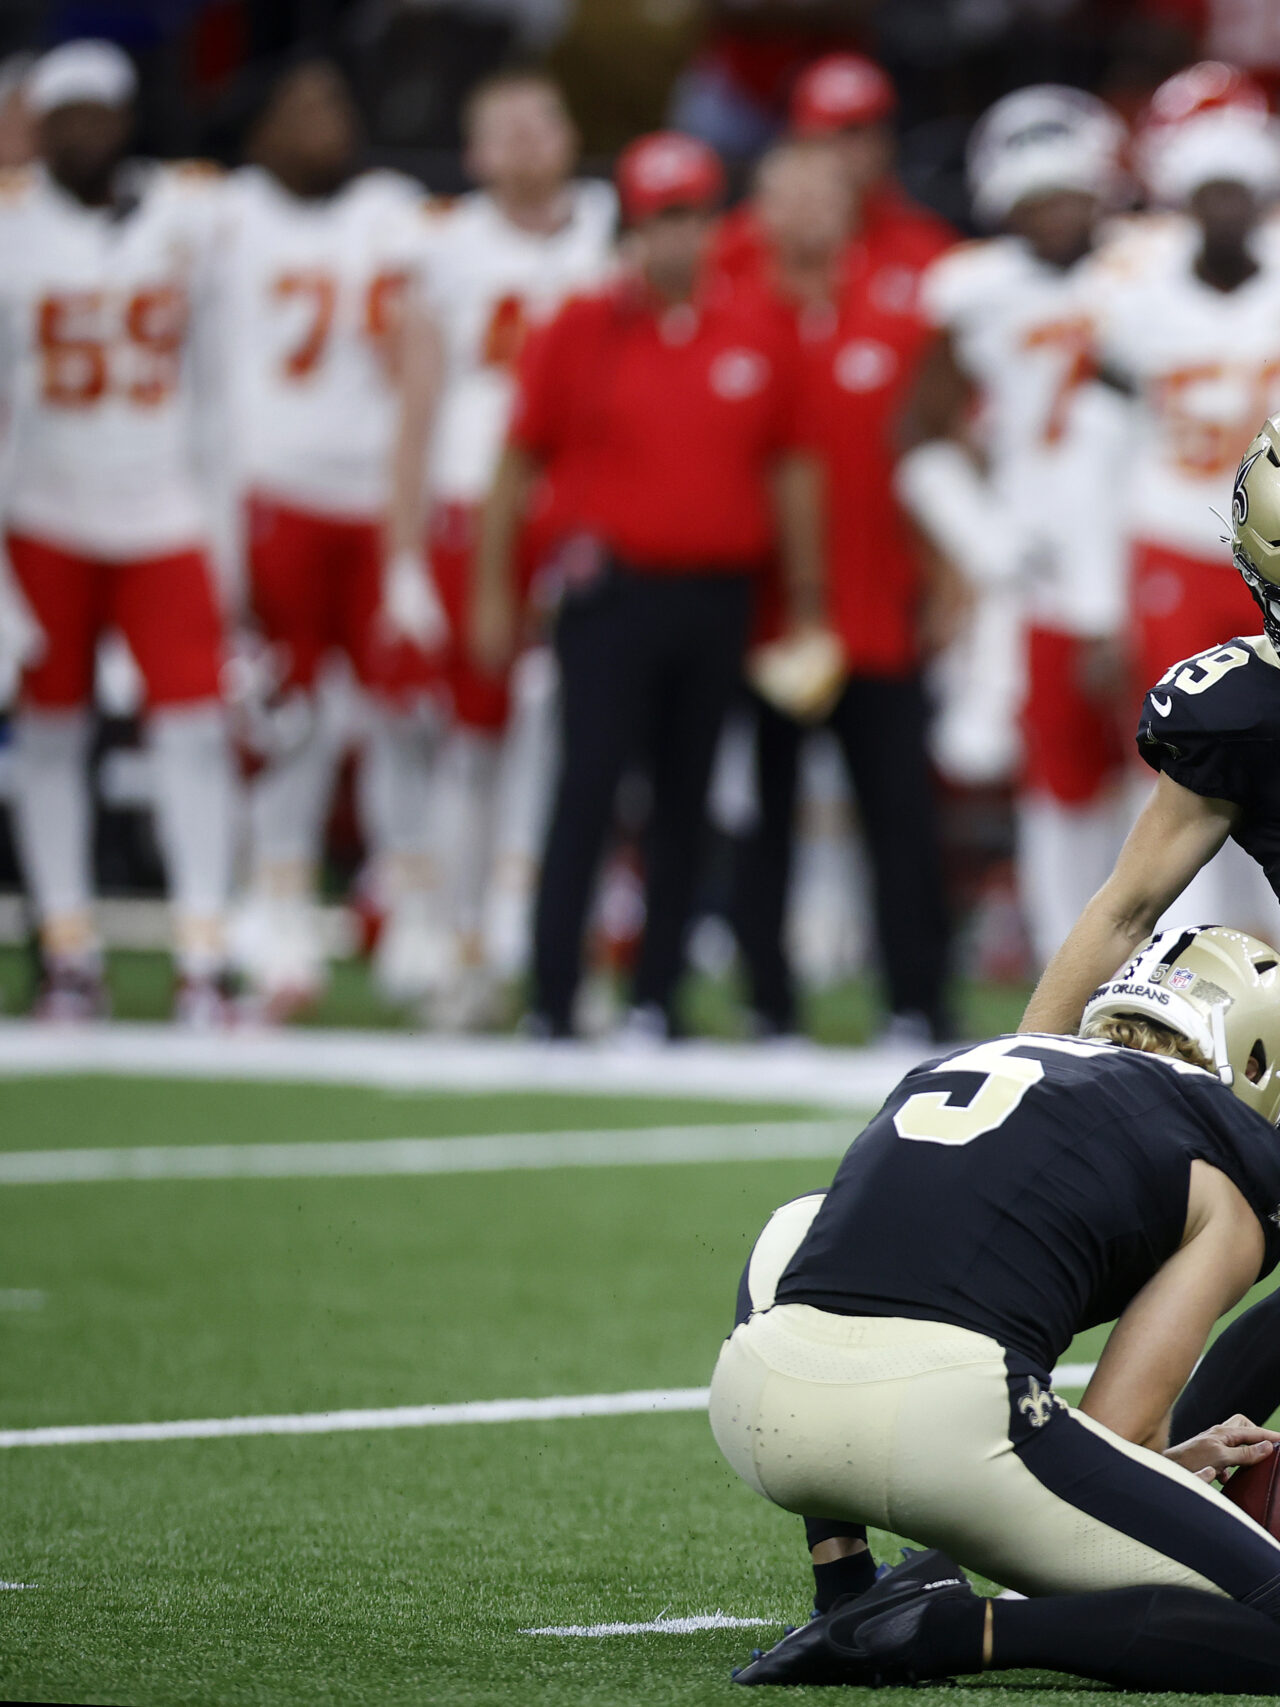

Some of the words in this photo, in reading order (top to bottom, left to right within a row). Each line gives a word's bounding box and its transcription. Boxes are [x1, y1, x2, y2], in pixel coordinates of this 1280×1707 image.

[1149, 963, 1170, 983] 5
[1171, 975, 1189, 988] NFL
[1112, 983, 1170, 1005] ORLEANS
[892, 1034, 1119, 1146] 5
